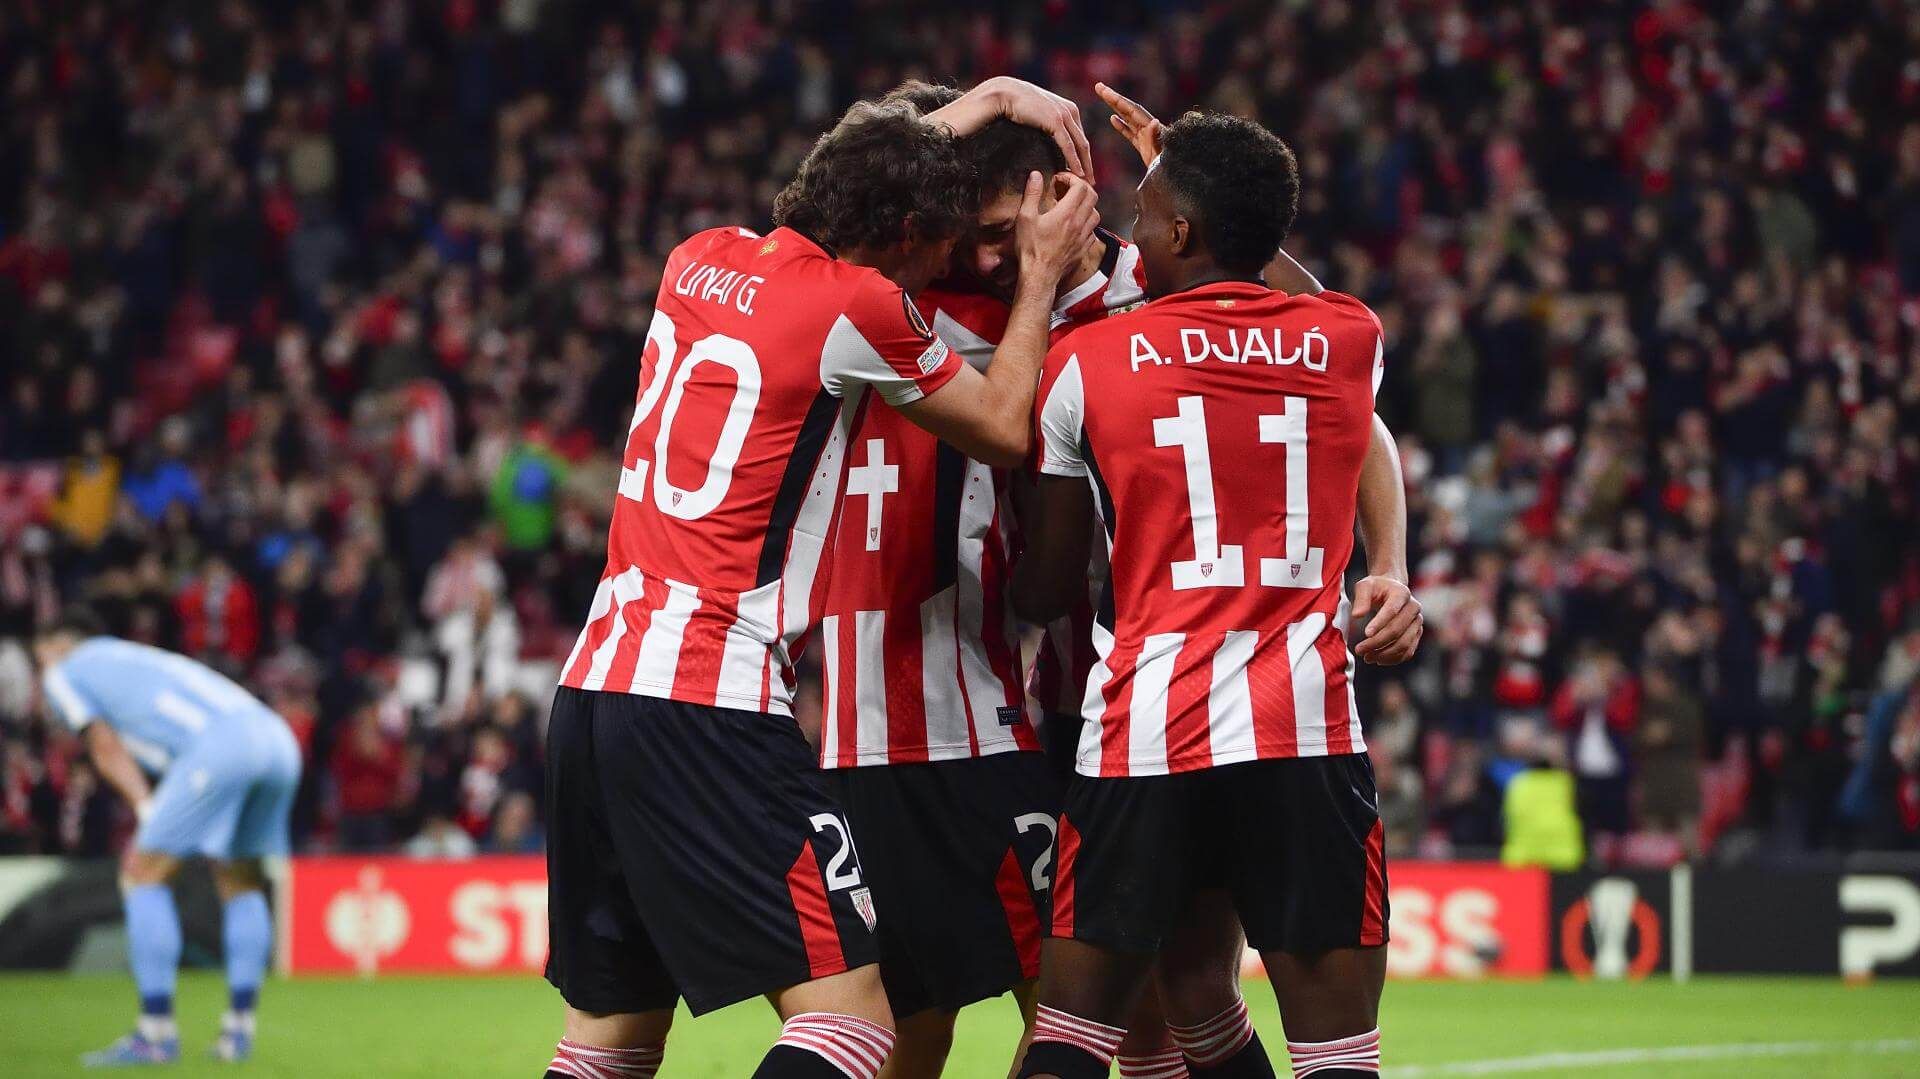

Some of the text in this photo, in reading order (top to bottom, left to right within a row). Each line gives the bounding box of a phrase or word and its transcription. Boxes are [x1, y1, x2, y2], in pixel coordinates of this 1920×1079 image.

[676, 261, 766, 316] UNAI G.
[1130, 326, 1329, 373] A. DJALÓ
[618, 308, 762, 521] 20
[1152, 395, 1325, 591] 11
